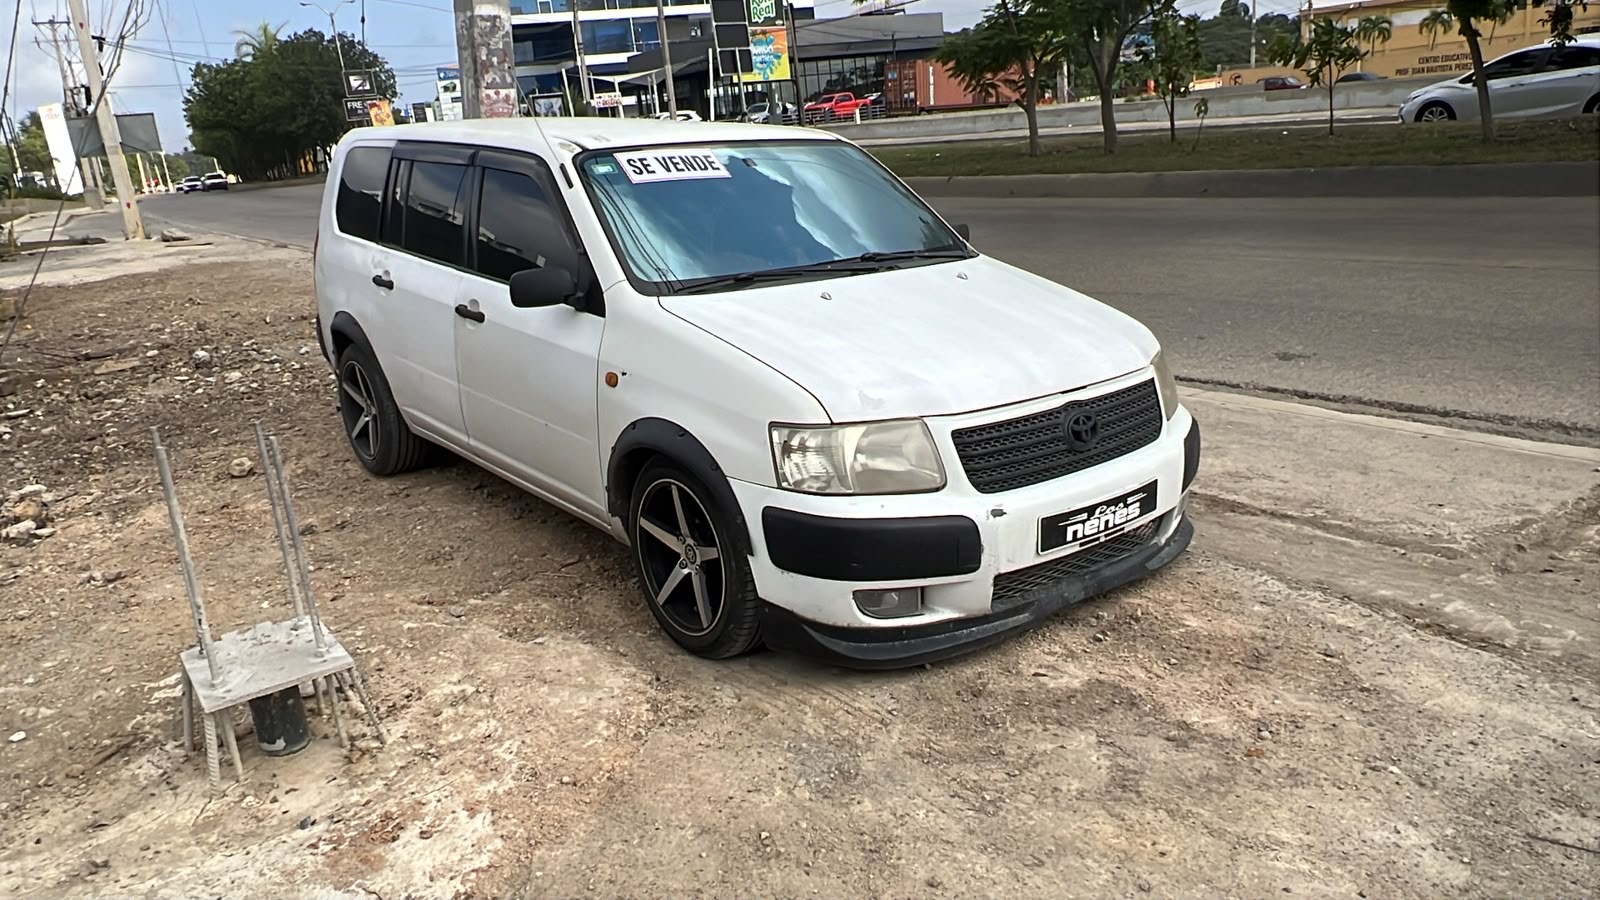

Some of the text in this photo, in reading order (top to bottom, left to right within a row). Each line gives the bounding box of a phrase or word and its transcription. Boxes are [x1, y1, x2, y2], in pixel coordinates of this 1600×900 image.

[752, 3, 774, 20] Real
[1418, 55, 1440, 64] CENTRO
[1411, 66, 1426, 75] JUAN
[1426, 64, 1453, 74] BAUTISTA
[626, 155, 720, 176] SE VENDE
[1090, 502, 1124, 520] Los
[1066, 501, 1140, 542] nenes
